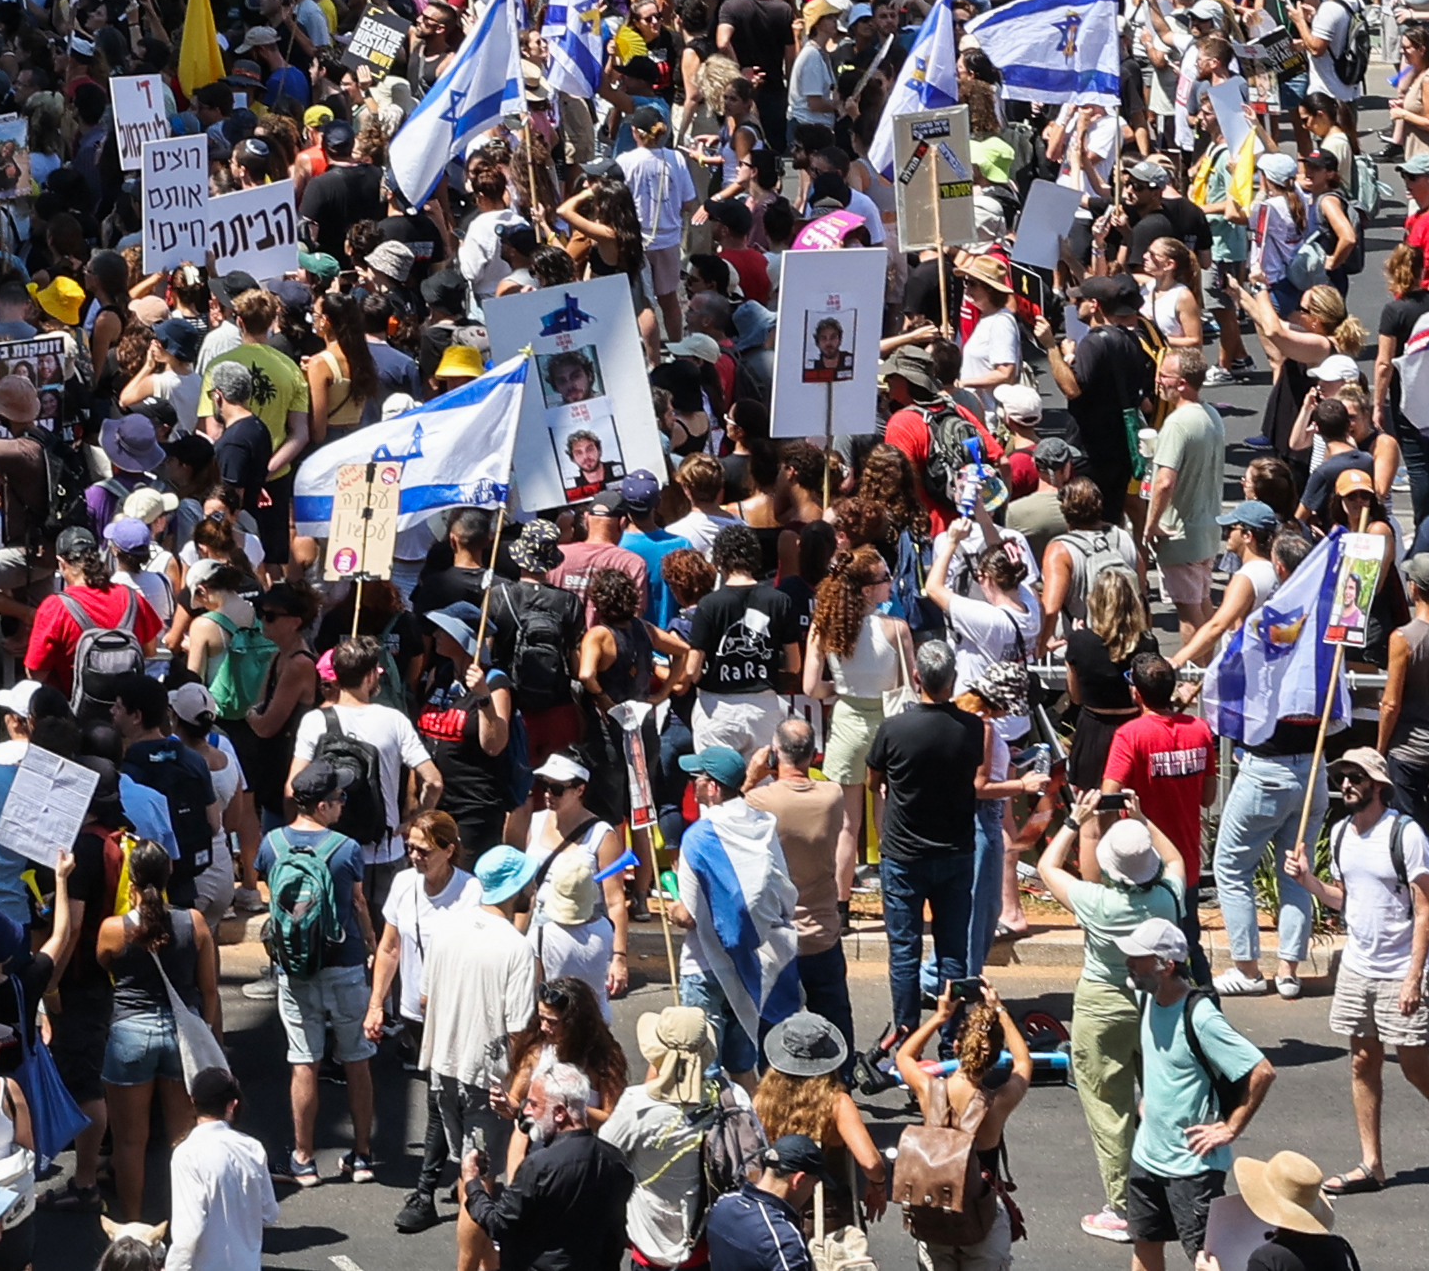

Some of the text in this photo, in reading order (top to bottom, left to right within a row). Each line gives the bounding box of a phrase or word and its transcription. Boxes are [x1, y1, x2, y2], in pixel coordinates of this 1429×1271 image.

[354, 28, 399, 59] HOSTAGE
[360, 18, 405, 46] CEASEFIRE
[348, 39, 372, 62] DEAL
[152, 146, 201, 174] רוצים
[147, 182, 203, 211] אותם
[149, 218, 207, 253] חיים!
[208, 203, 296, 261] הביתה
